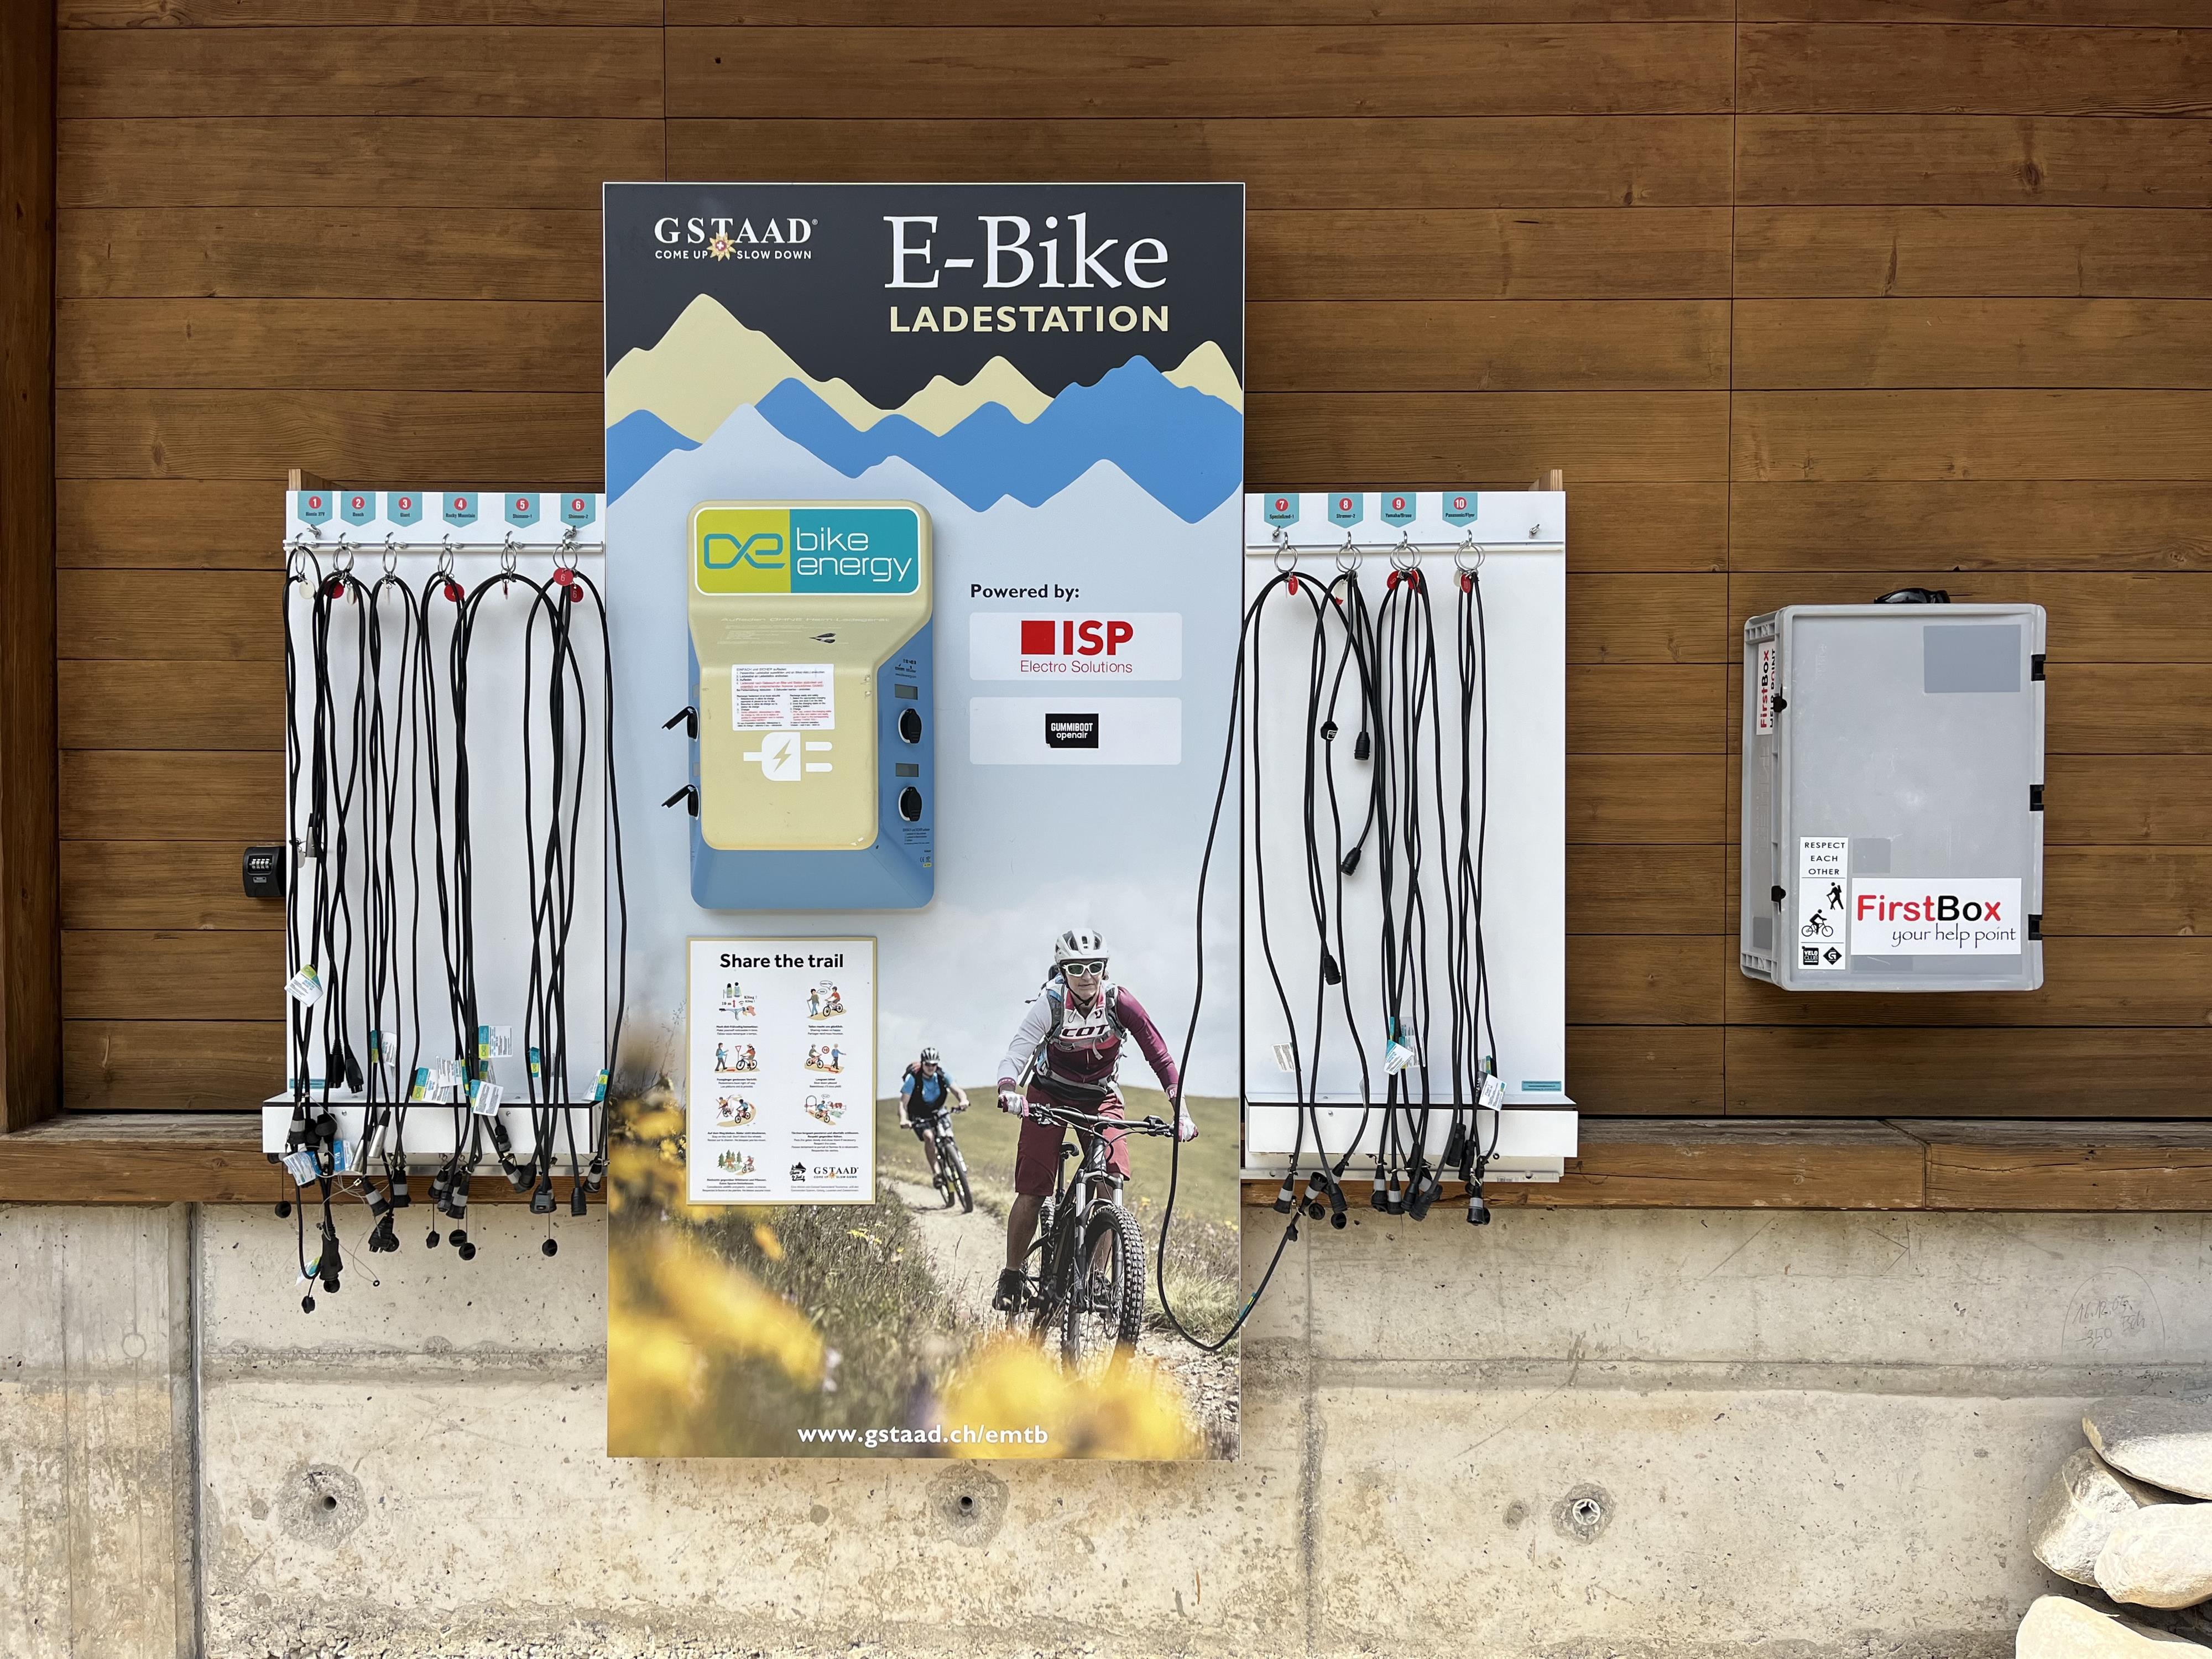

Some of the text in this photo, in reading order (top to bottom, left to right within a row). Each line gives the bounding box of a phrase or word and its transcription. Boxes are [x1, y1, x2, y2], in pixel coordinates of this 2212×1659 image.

[655, 250, 812, 259] COME UP SLOW DOWN
[883, 212, 1168, 289] E-Bike
[889, 305, 1169, 332] LADESTATION
[313, 498, 317, 507] 1
[356, 498, 361, 508] 2
[402, 499, 408, 508] 3
[457, 499, 463, 509] 4
[519, 500, 525, 509] 5
[576, 500, 581, 510] 6
[1279, 500, 1285, 510] 7
[1343, 500, 1348, 509] 8
[1396, 499, 1401, 508] 9
[1455, 499, 1464, 508] 10
[796, 527, 869, 551] bike
[796, 557, 912, 582] energy
[572, 590, 577, 598] 6
[970, 583, 1079, 602] Powered by:
[1063, 620, 1134, 656] ISP
[1020, 660, 1133, 673] Electro Solutions
[1760, 649, 1770, 728] FirstBox
[1050, 722, 1093, 732] GUMMIBOOT
[1056, 731, 1088, 740] openair
[1856, 894, 2001, 922] FirstBox
[1891, 922, 2017, 949] your help point
[719, 953, 844, 969] Share the trail
[1062, 1024, 1109, 1037] COT
[813, 1166, 857, 1175] GSTAAD
[797, 1425, 1048, 1448] www.gstaad.ch/emtb
